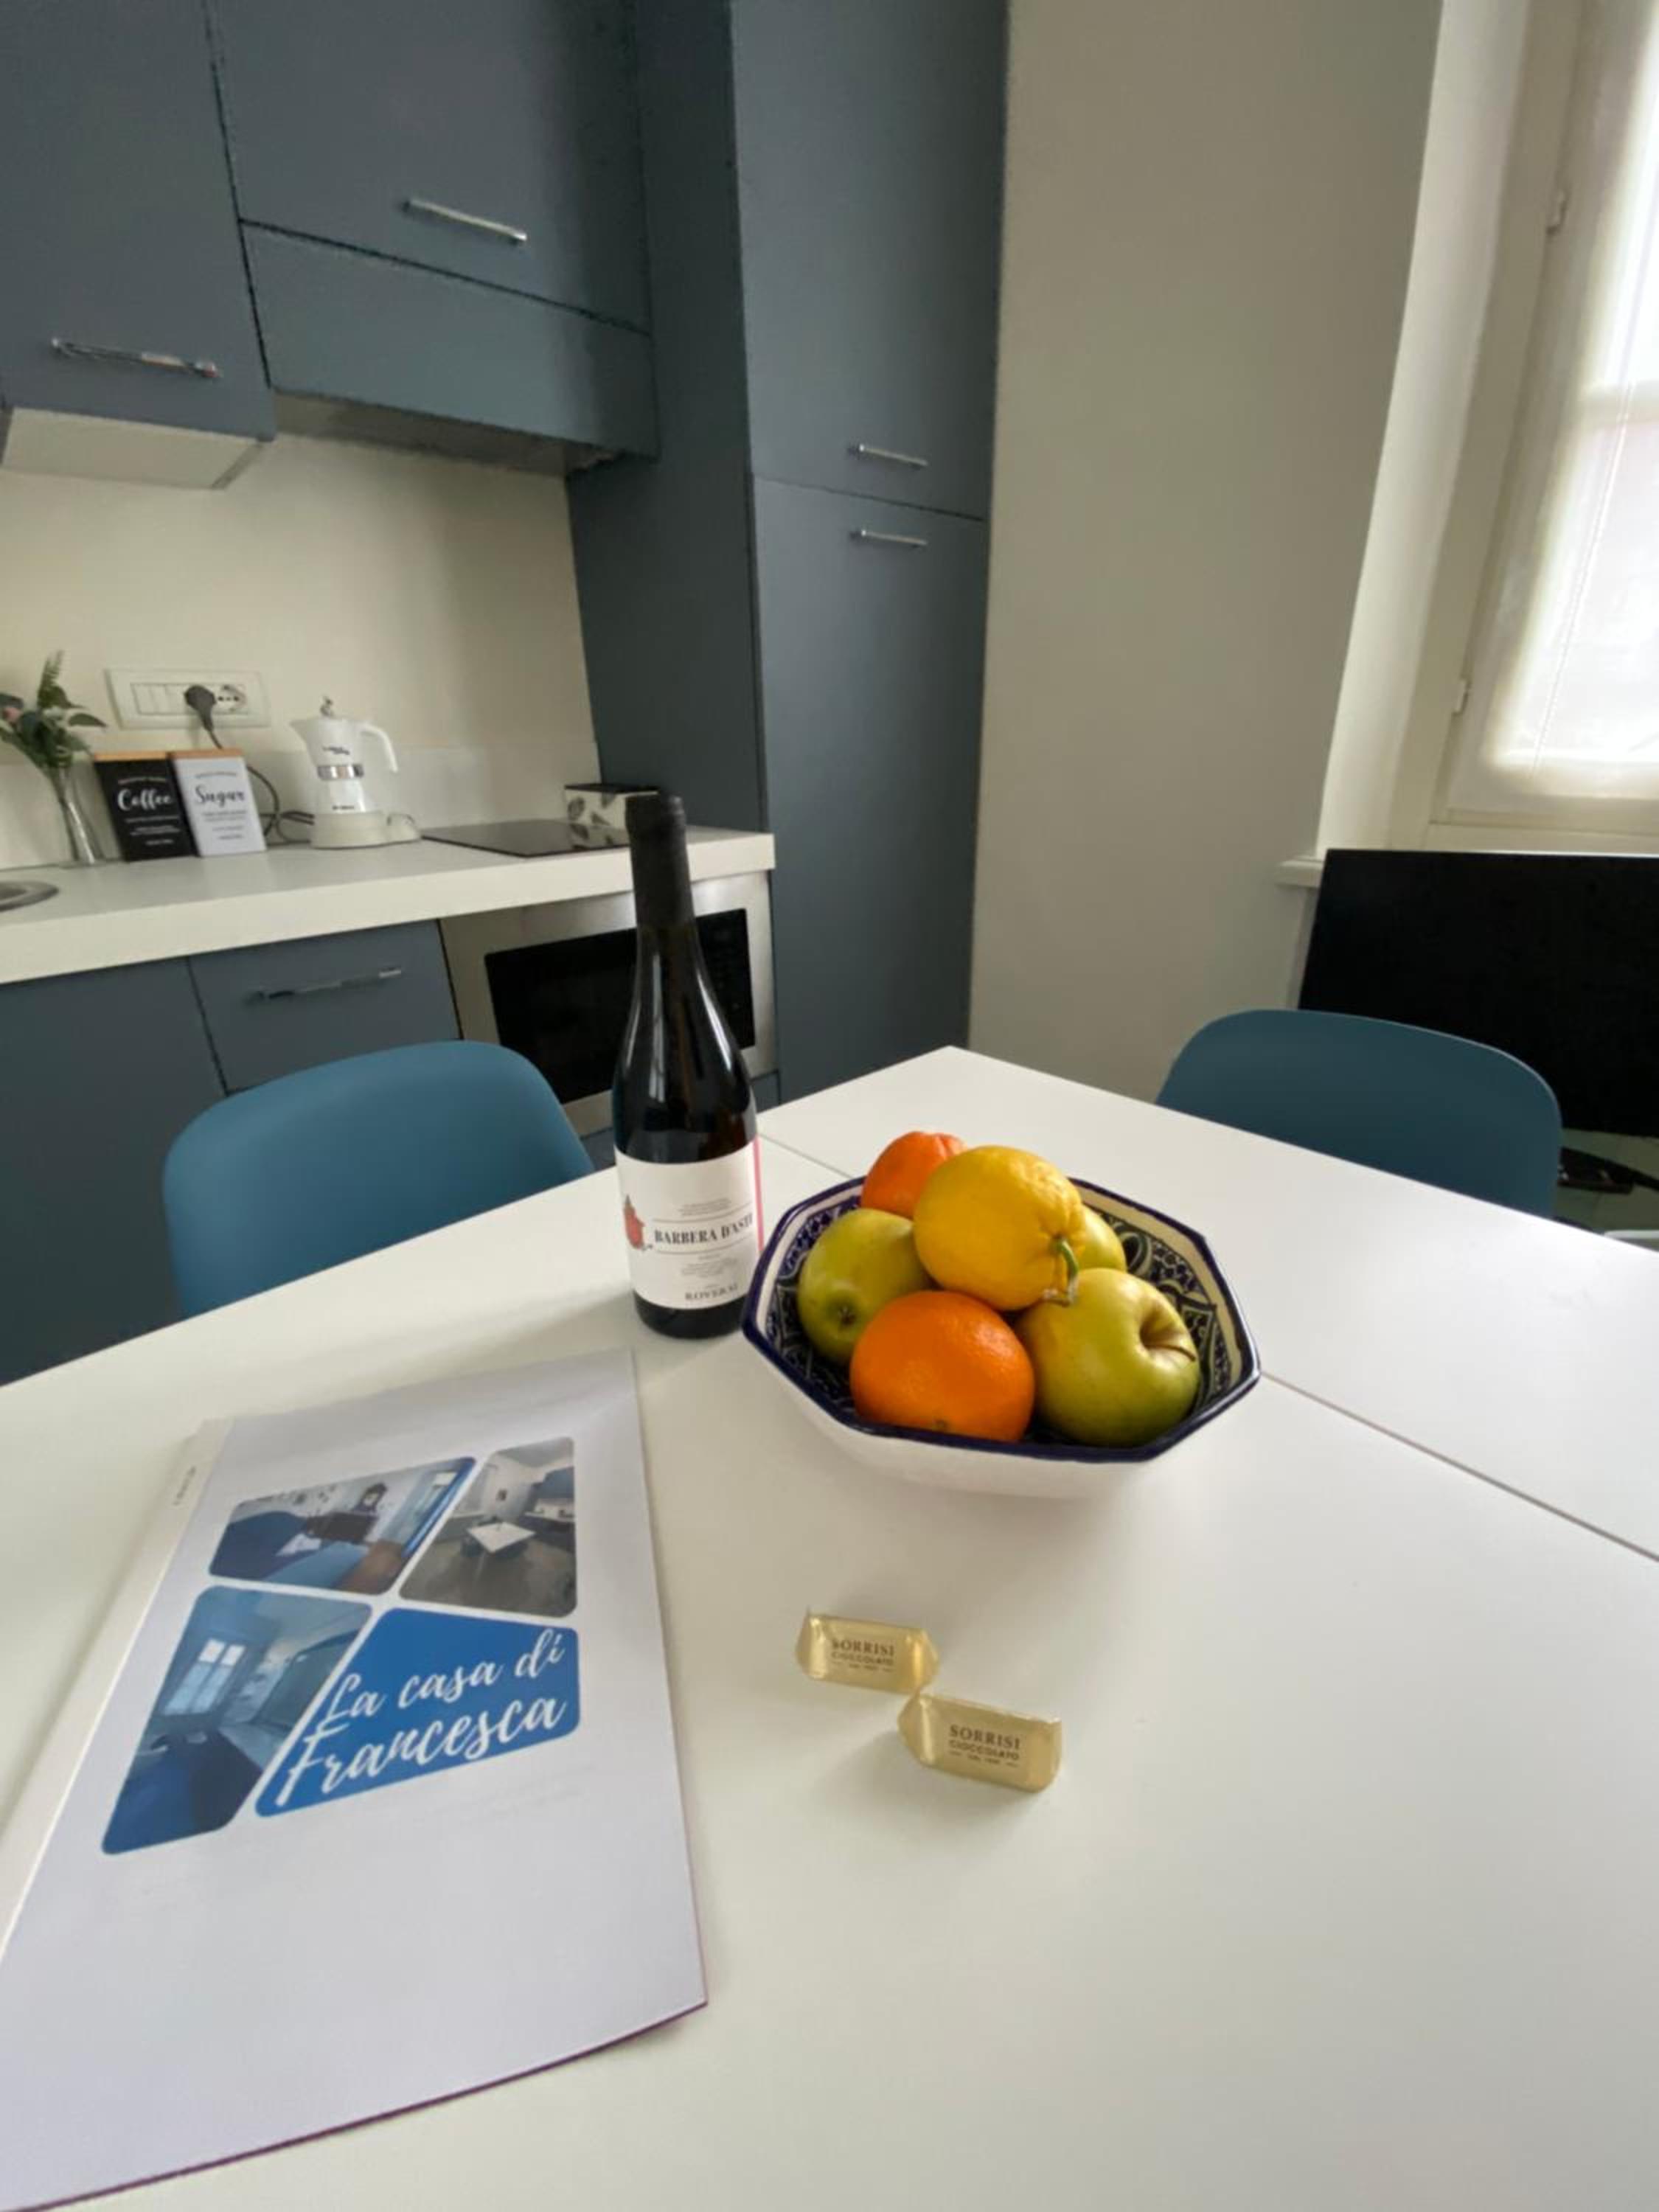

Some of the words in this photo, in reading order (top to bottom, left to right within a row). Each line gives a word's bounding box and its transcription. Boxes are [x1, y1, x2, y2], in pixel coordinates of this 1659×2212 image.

[117, 787, 172, 811] Coffee
[195, 784, 246, 807] Sugar
[653, 1228, 718, 1245] BARBERA
[831, 1638, 894, 1657] SORRISI
[320, 1673, 387, 1726] La
[398, 1661, 504, 1710] casa
[515, 1628, 565, 1678] di
[949, 1724, 1020, 1750] SORRISI
[275, 1698, 568, 1807] Francesca
